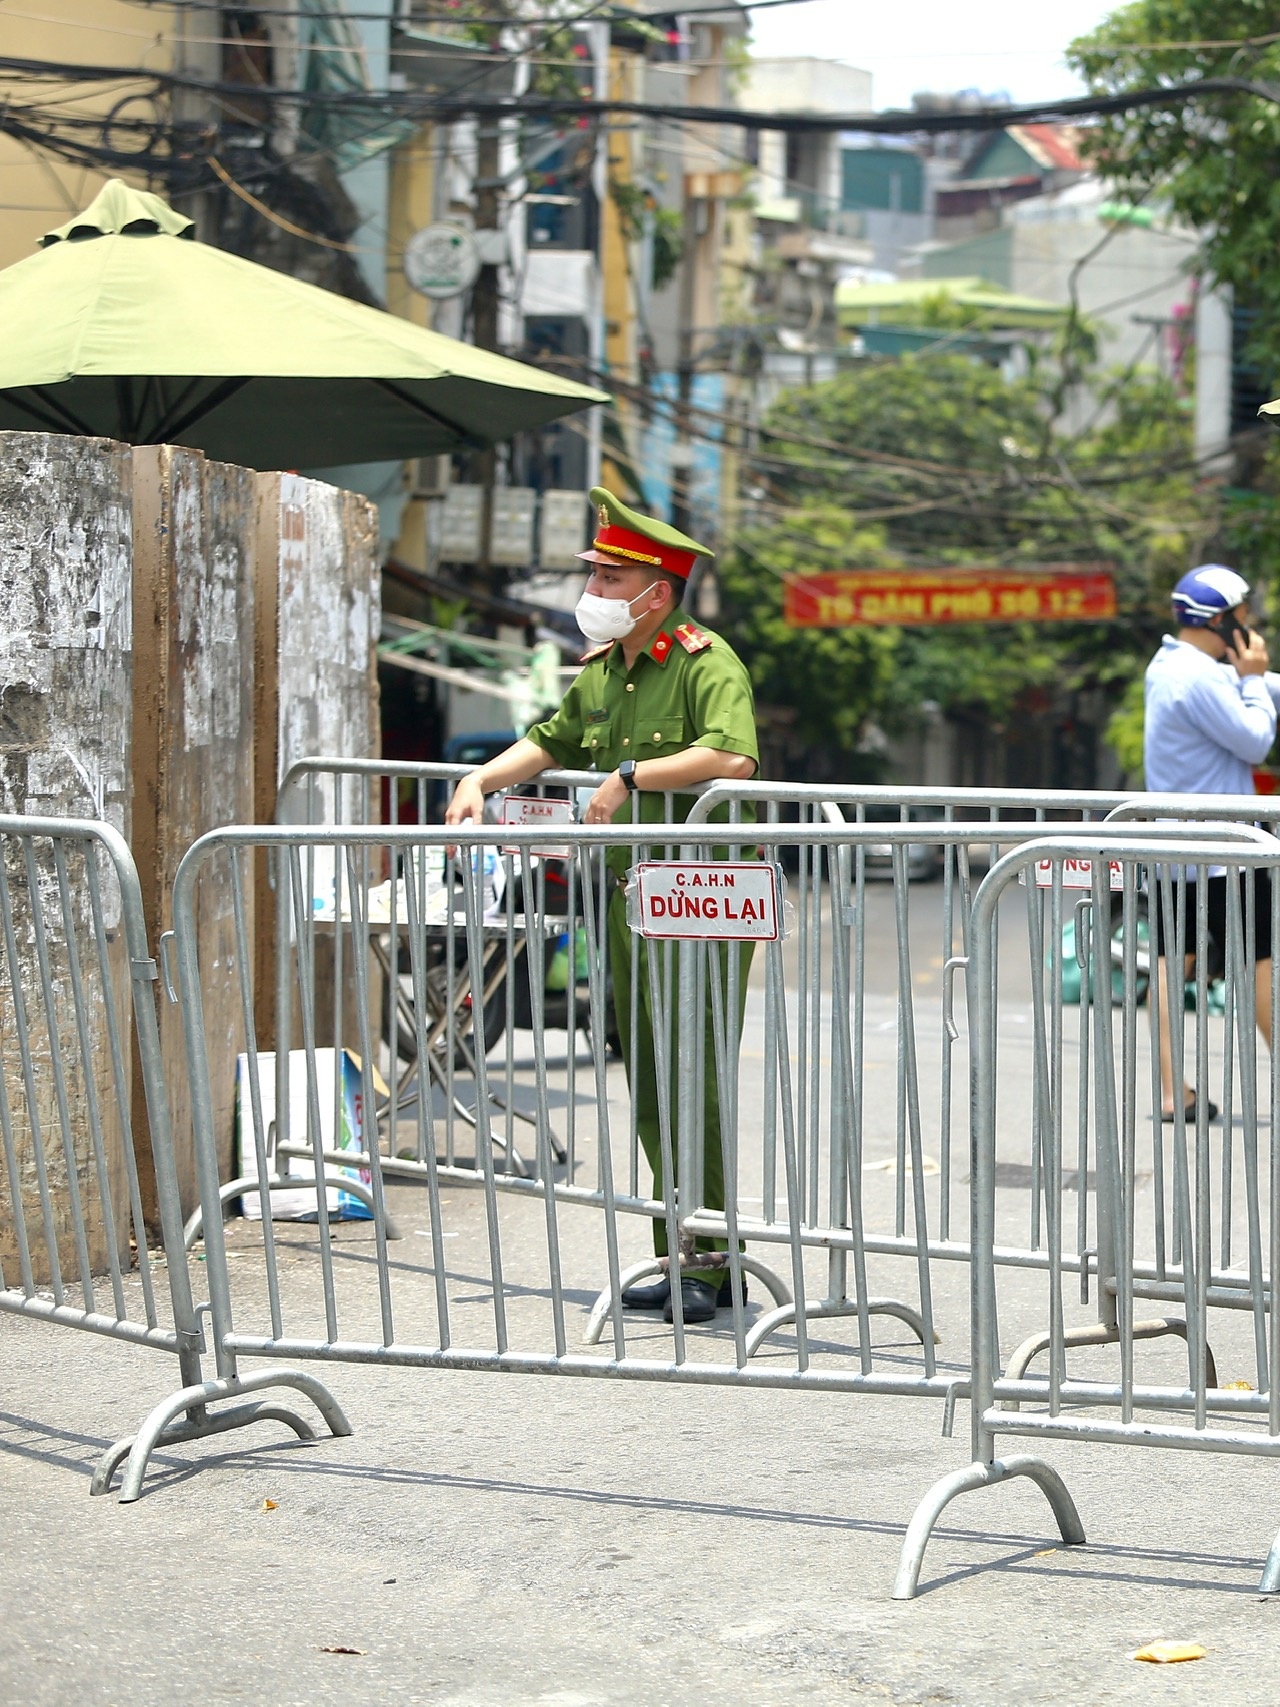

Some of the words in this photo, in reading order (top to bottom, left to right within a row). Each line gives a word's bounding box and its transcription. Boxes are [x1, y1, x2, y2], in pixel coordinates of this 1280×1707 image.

[1049, 589, 1084, 614] 12
[1039, 859, 1091, 872] DNG
[676, 872, 735, 887] C.A.H.N
[650, 888, 718, 919] DỪNG
[725, 897, 766, 925] LẠI
